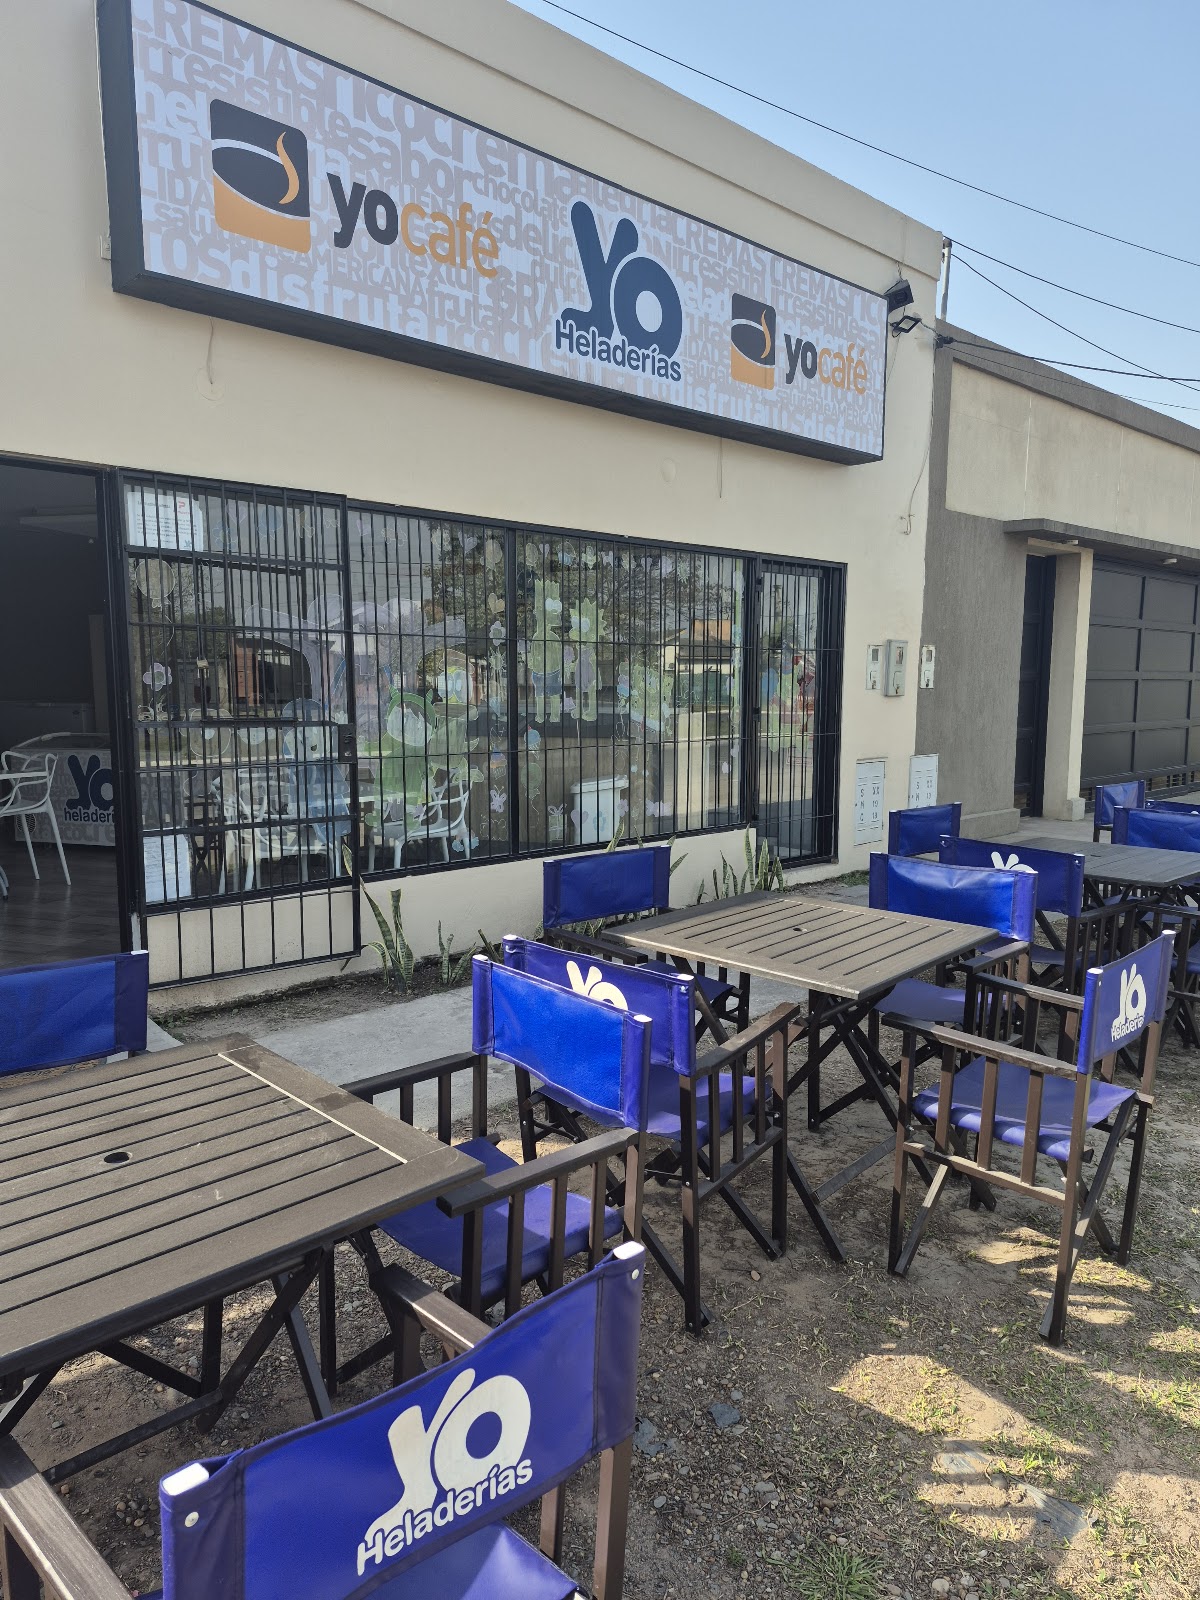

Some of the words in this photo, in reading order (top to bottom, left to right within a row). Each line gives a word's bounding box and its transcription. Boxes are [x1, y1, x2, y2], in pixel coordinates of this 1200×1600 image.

[326, 172, 499, 279] yocafé
[555, 319, 682, 382] Heladerías
[784, 333, 868, 395] yocafé
[357, 1458, 534, 1576] Heladerías
